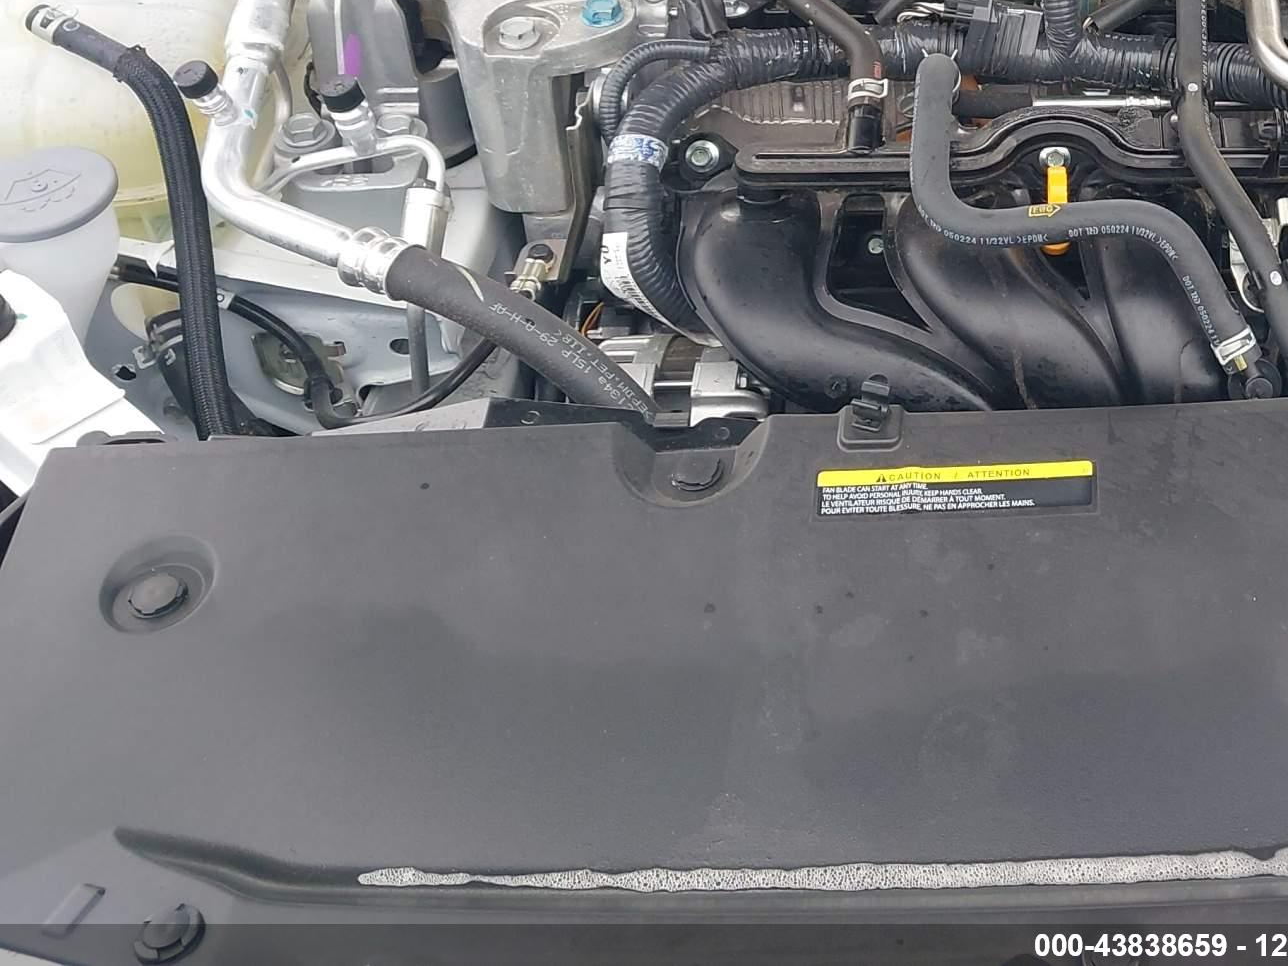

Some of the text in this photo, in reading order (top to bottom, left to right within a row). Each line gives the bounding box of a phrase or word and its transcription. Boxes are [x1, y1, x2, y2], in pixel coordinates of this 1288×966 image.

[1101, 224, 1129, 234] 050224
[889, 472, 941, 482] CAUTION
[967, 468, 1030, 479] ATTENTION
[871, 484, 890, 492] START
[912, 482, 928, 490] TIME.
[830, 499, 875, 507] VENTILATEUR
[876, 498, 900, 506] RISQUE
[974, 493, 1006, 501] MOMENT.
[848, 492, 868, 500] AVOID
[869, 491, 900, 499] PERSONAL
[924, 489, 939, 497] KEEP
[821, 507, 841, 515] POUR
[865, 505, 888, 513] TOUTE
[923, 503, 933, 511] NE
[934, 503, 946, 511] PAS
[957, 501, 999, 509] APPROCHER
[1011, 499, 1035, 507] MAINS.
